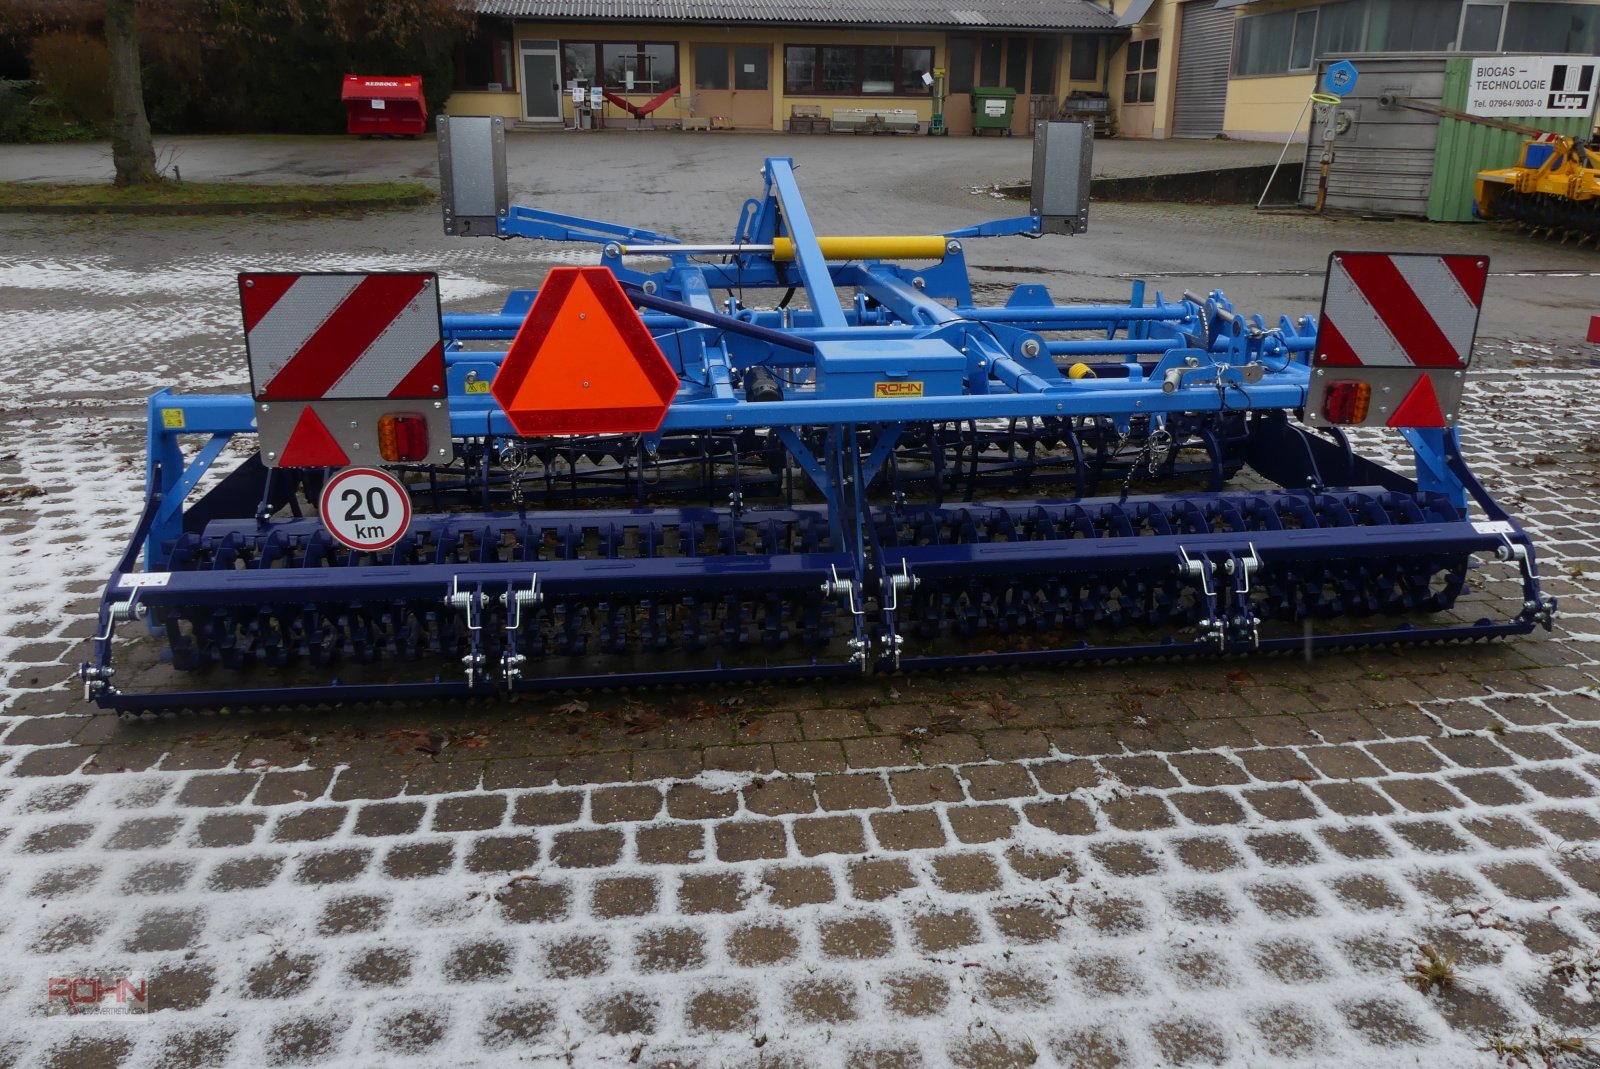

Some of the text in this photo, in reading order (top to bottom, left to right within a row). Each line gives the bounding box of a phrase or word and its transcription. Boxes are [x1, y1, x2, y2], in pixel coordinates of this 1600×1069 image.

[1477, 66, 1515, 77] BIOGAS
[1476, 80, 1546, 90] TECHNOLOGIE
[1473, 99, 1543, 108] Tel. 07964/9003-0
[876, 383, 922, 395] ROHN
[341, 486, 390, 522] 20
[354, 523, 385, 539] km
